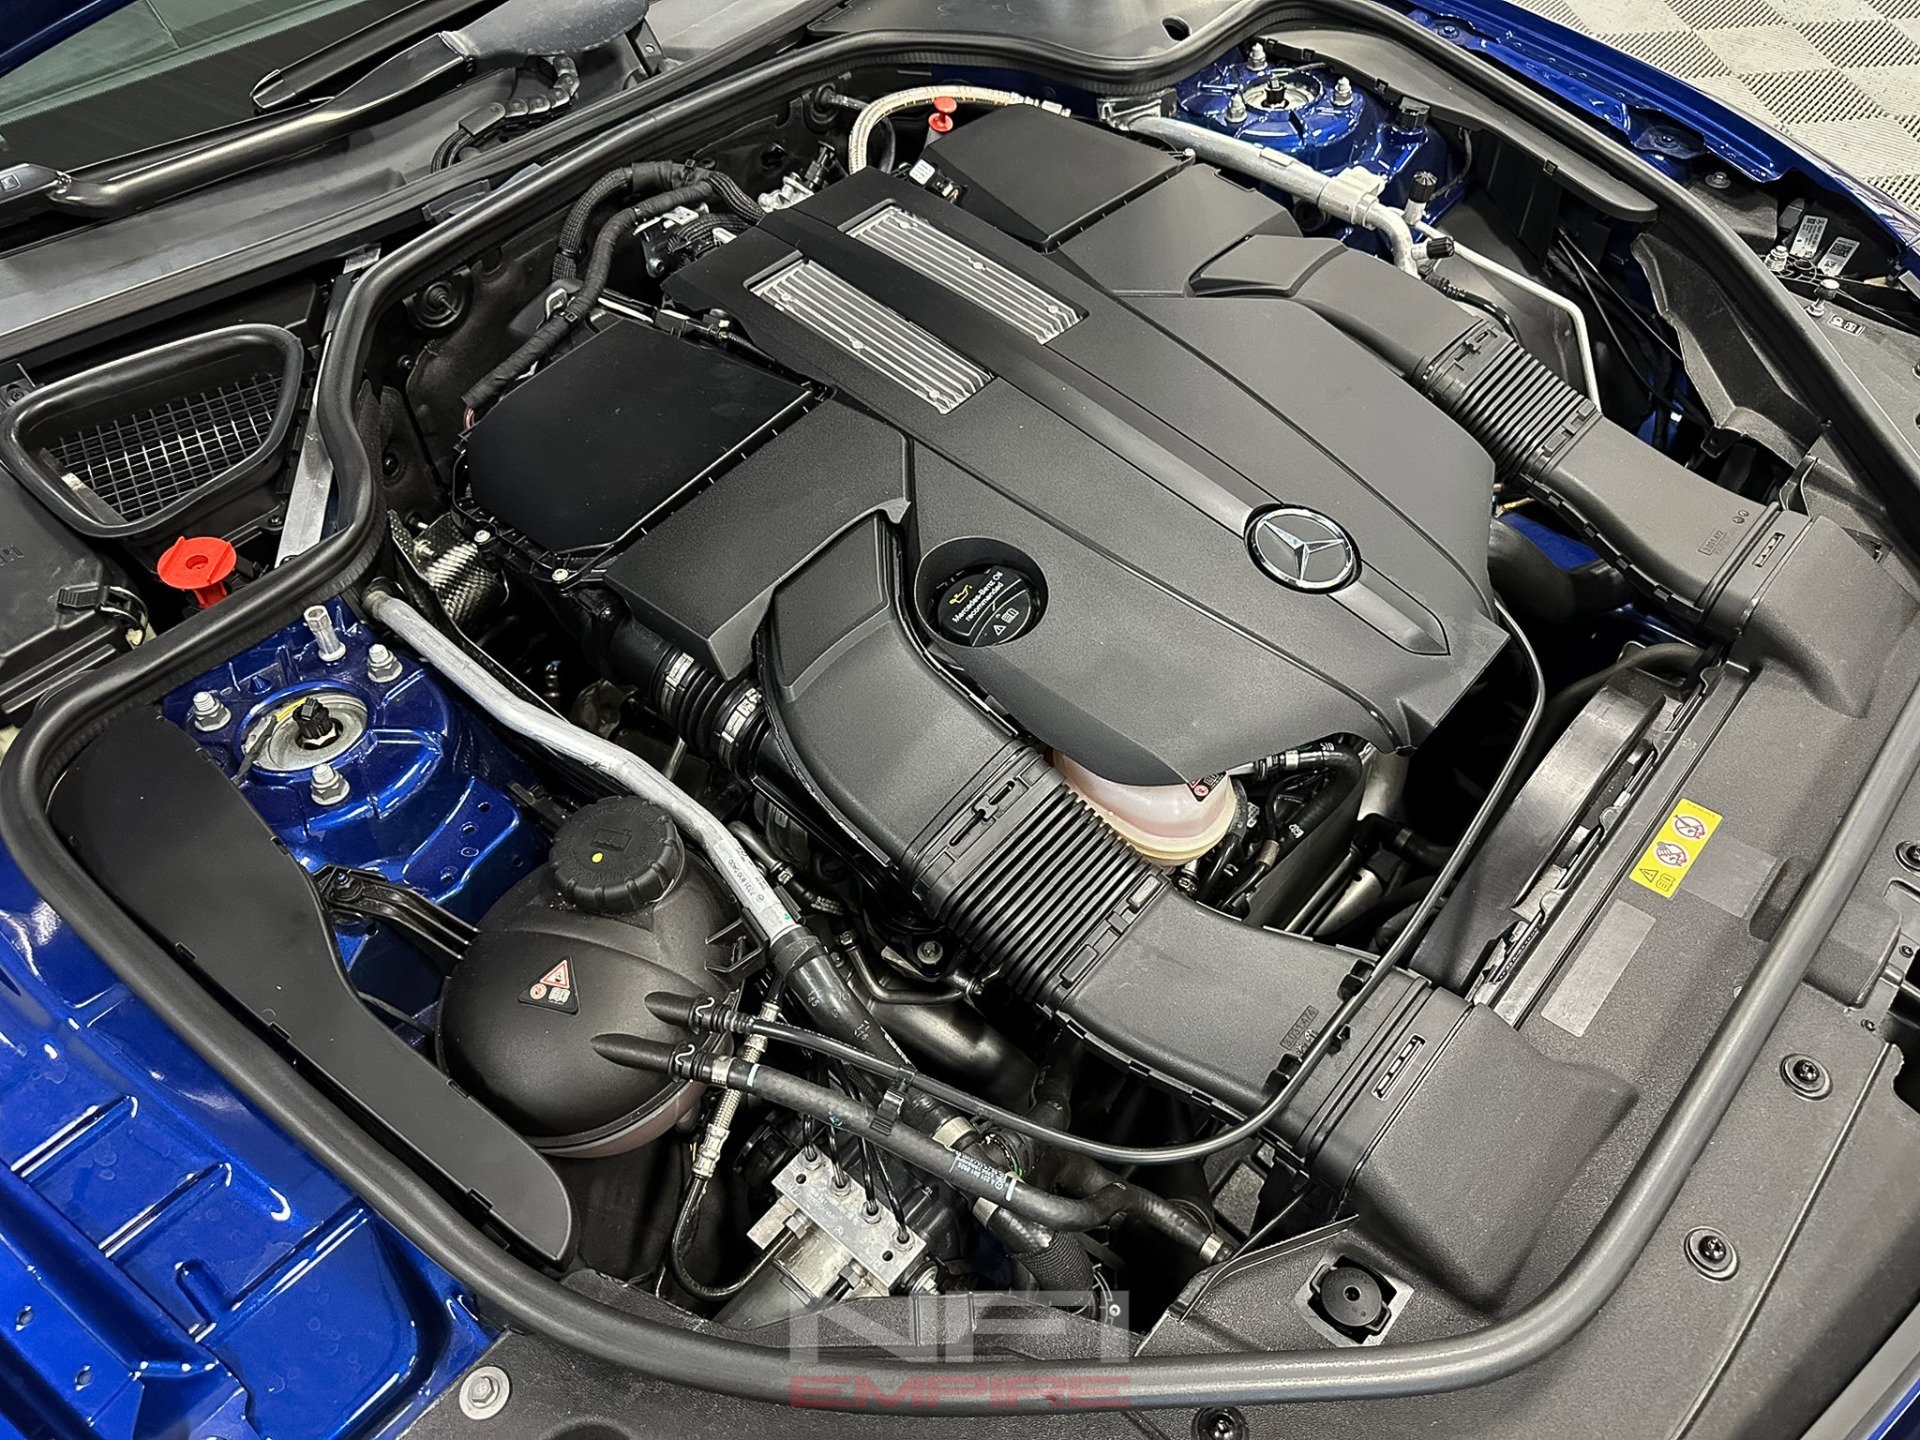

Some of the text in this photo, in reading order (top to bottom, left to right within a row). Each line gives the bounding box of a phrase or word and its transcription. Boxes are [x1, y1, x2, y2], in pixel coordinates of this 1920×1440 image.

[952, 571, 1003, 622] Mercedes-Benz Oil
[966, 581, 1004, 621] recommended
